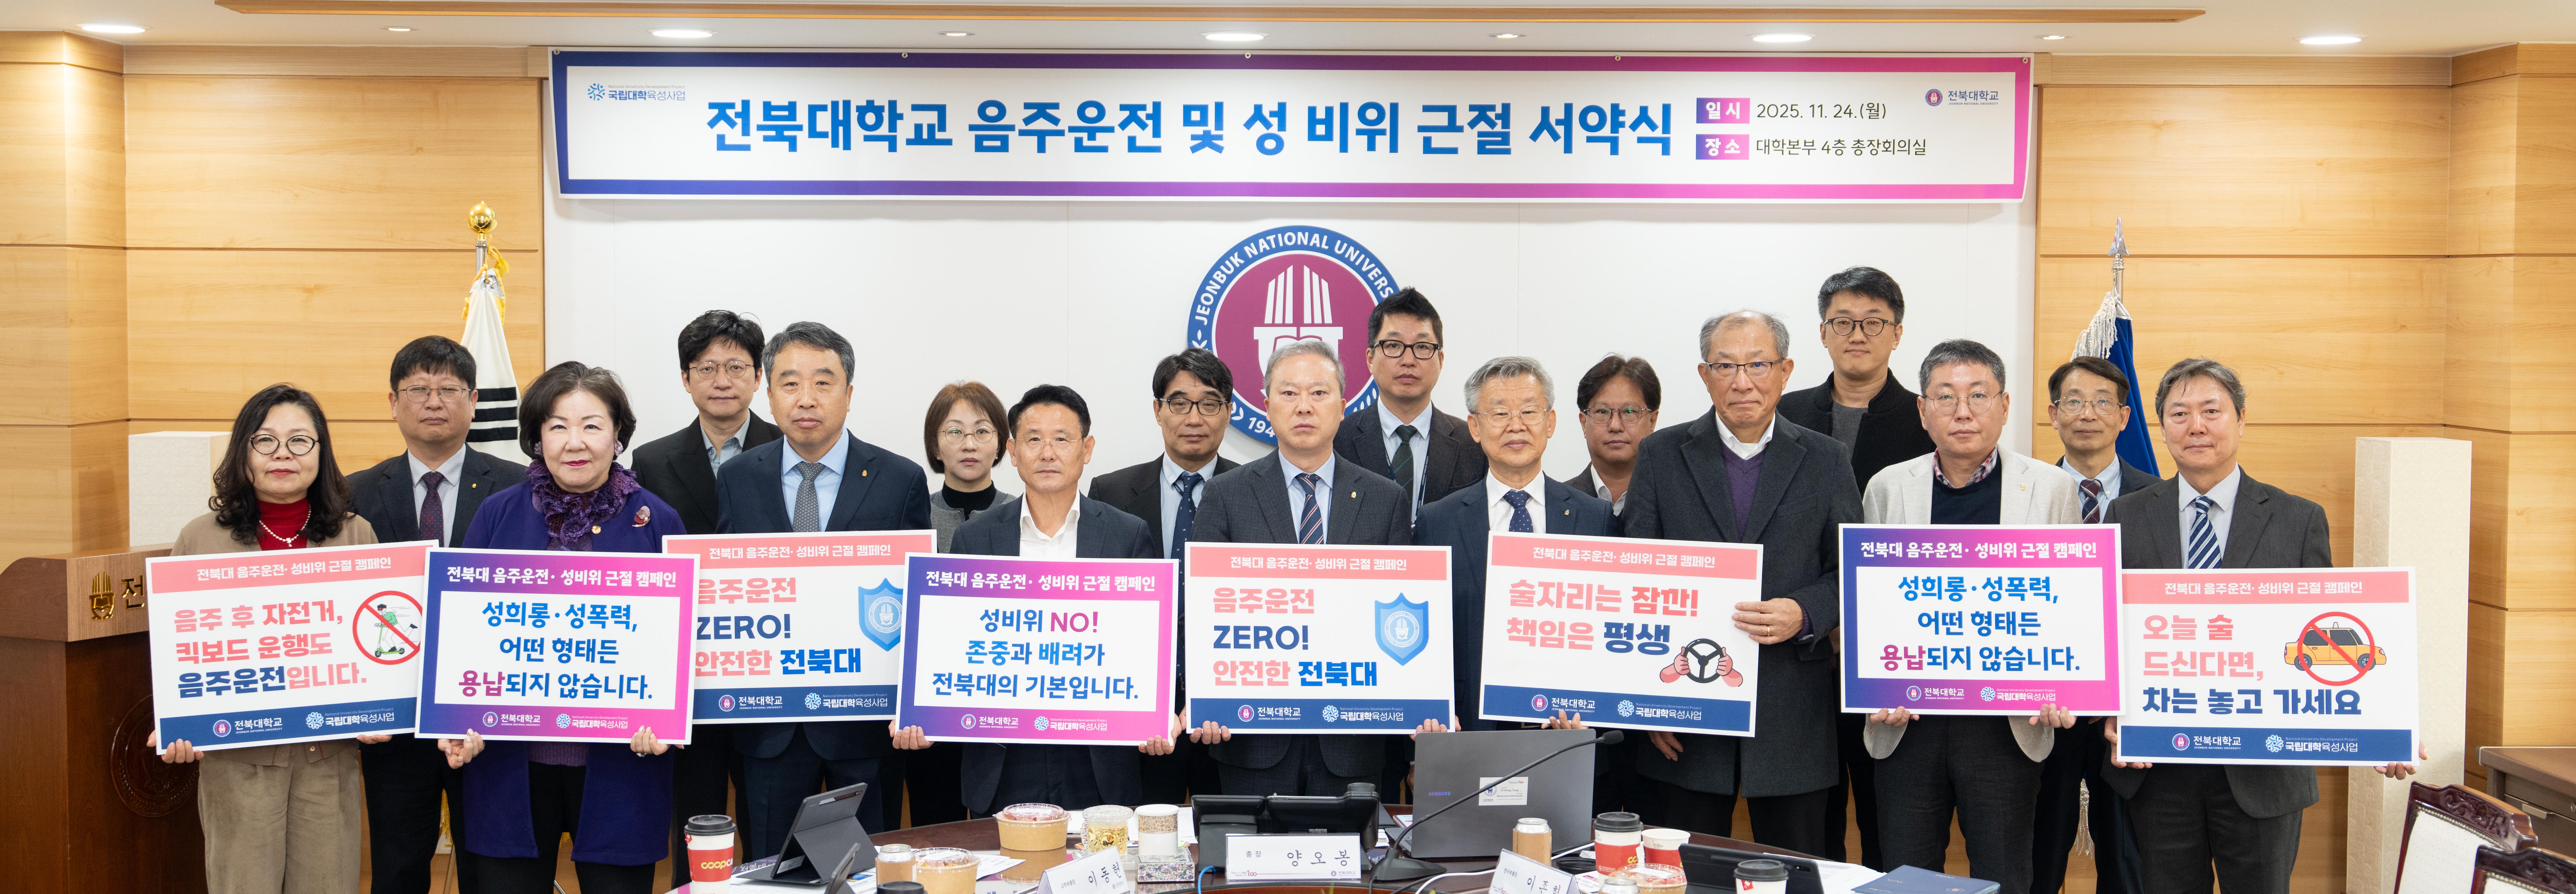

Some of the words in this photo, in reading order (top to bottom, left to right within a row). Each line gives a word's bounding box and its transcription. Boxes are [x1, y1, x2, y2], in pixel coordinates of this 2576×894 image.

[608, 90, 685, 101] 국립대학육성사업
[1948, 90, 1999, 101] 전북대학교
[1757, 104, 1803, 118] 2025.
[1809, 104, 1827, 118] 11.
[1834, 103, 1886, 119] 24.(월)
[707, 99, 953, 152] 전북대학교
[968, 100, 1162, 154] 음주운전
[1183, 101, 1224, 154] 및
[1243, 102, 1286, 155] 성
[1308, 102, 1399, 153] 비위
[1417, 103, 1511, 155] 근절
[1529, 103, 1671, 155] 서약식
[1757, 139, 1816, 155] 대학본부
[1821, 139, 1847, 156] 4층
[1851, 139, 1926, 156] 총장회의실
[1195, 252, 1244, 325] JEONBUK
[1244, 232, 1329, 259] NATIONAL
[1334, 239, 1394, 299] UNIVERS
[1248, 417, 1275, 437] 194
[709, 548, 743, 559] 전북대
[796, 546, 829, 557] 성비위
[832, 545, 853, 557] 근절
[857, 544, 891, 556] 캠페인
[1533, 547, 1567, 560] 전북대
[1620, 552, 1652, 565] 성비위
[1655, 554, 1677, 566] 근절
[1681, 555, 1715, 568] 캠페인
[1861, 542, 1902, 557] 전북대
[1974, 542, 2017, 559] 성비위
[2021, 543, 2049, 558] 근절
[2054, 542, 2096, 558] 캠페인
[197, 567, 234, 581] 전북대
[290, 561, 326, 575] 성비위
[329, 560, 352, 572] 근절
[355, 557, 391, 571] 캠페인
[1231, 557, 1263, 568] 전북대
[1315, 558, 1346, 570] 성비위
[1350, 559, 1370, 570] 근절
[1374, 559, 1407, 570] 캠페인
[447, 566, 489, 582] 전북대
[560, 569, 601, 586] 성비위
[605, 571, 632, 586] 근절
[636, 571, 676, 587] 캠페인
[926, 571, 968, 587] 전북대
[1038, 575, 1079, 591] 성비위
[1083, 576, 1110, 591] 근절
[1114, 576, 1155, 591] 캠페인
[698, 577, 796, 604] 음주운전
[1509, 579, 1622, 613] 술자리는
[1631, 586, 1698, 617] 잠깐!
[2165, 583, 2201, 595] 전북대
[2258, 582, 2293, 594] 성비위
[2297, 582, 2321, 594] 근절
[2324, 582, 2362, 593] 캠페인
[1213, 588, 1314, 614] 음주운전
[174, 608, 223, 633] 음주
[231, 605, 255, 629] 후
[262, 599, 343, 626] 자전거,
[980, 609, 1043, 632] 성비위
[1051, 611, 1098, 633] NO!
[1918, 611, 1963, 635] 어떤
[1971, 611, 2041, 637] 형태든
[696, 614, 790, 640] ZERO!
[1506, 617, 1594, 651] 책임은
[1604, 622, 1670, 655] 평생
[2143, 615, 2197, 640] 오늘
[2207, 615, 2233, 640] 술
[1213, 625, 1308, 650] ZERO!
[176, 638, 250, 664] 킥보드
[258, 632, 333, 659] 운행도
[500, 637, 544, 662] 어떤
[552, 638, 619, 664] 형태든
[966, 640, 1032, 666] 존중과
[1039, 642, 1105, 666] 배려가
[1880, 644, 1971, 671] 용납되지
[1979, 646, 2080, 672] 않습니다.
[695, 650, 772, 677] 안전한
[780, 648, 860, 675] 전북대
[2143, 651, 2263, 681] 드신다면,
[178, 662, 367, 699] 음주운전입니다.
[1213, 660, 1290, 686] 안전한
[1298, 661, 1376, 686] 전북대
[459, 670, 550, 697] 용납되지
[558, 673, 652, 699] 않습니다.
[932, 672, 1018, 697] 전북대의
[1026, 675, 1138, 699] 기본입니다.
[1924, 688, 1965, 697] 전북대학교
[738, 695, 783, 706] 전북대학교
[822, 698, 887, 708] 국립대학육성사업
[1551, 698, 1596, 709] 전북대학교
[1996, 692, 2056, 701] 국립대학육성사업
[2142, 687, 2198, 714] 차는
[2208, 689, 2263, 715] 놓고
[2273, 689, 2361, 715] 가세요
[325, 712, 394, 726] 국립대학육성사업
[501, 714, 541, 723] 전북대학교
[979, 716, 1019, 726] 전북대학교
[1257, 707, 1301, 717] 전북대학교
[1340, 712, 1403, 721] 국립대학육성사업
[1635, 707, 1701, 720] 국립대학육성사업
[235, 717, 283, 730] 전북대학교
[571, 719, 628, 729] 국립대학육성사업
[1050, 722, 1107, 731] 국립대학육성사업
[2193, 736, 2241, 746] 전북대학교
[2285, 742, 2358, 752] 국립대학육성사업
[1504, 868, 1518, 877] 연구부총장
[1061, 879, 1076, 888] 교학부총장
